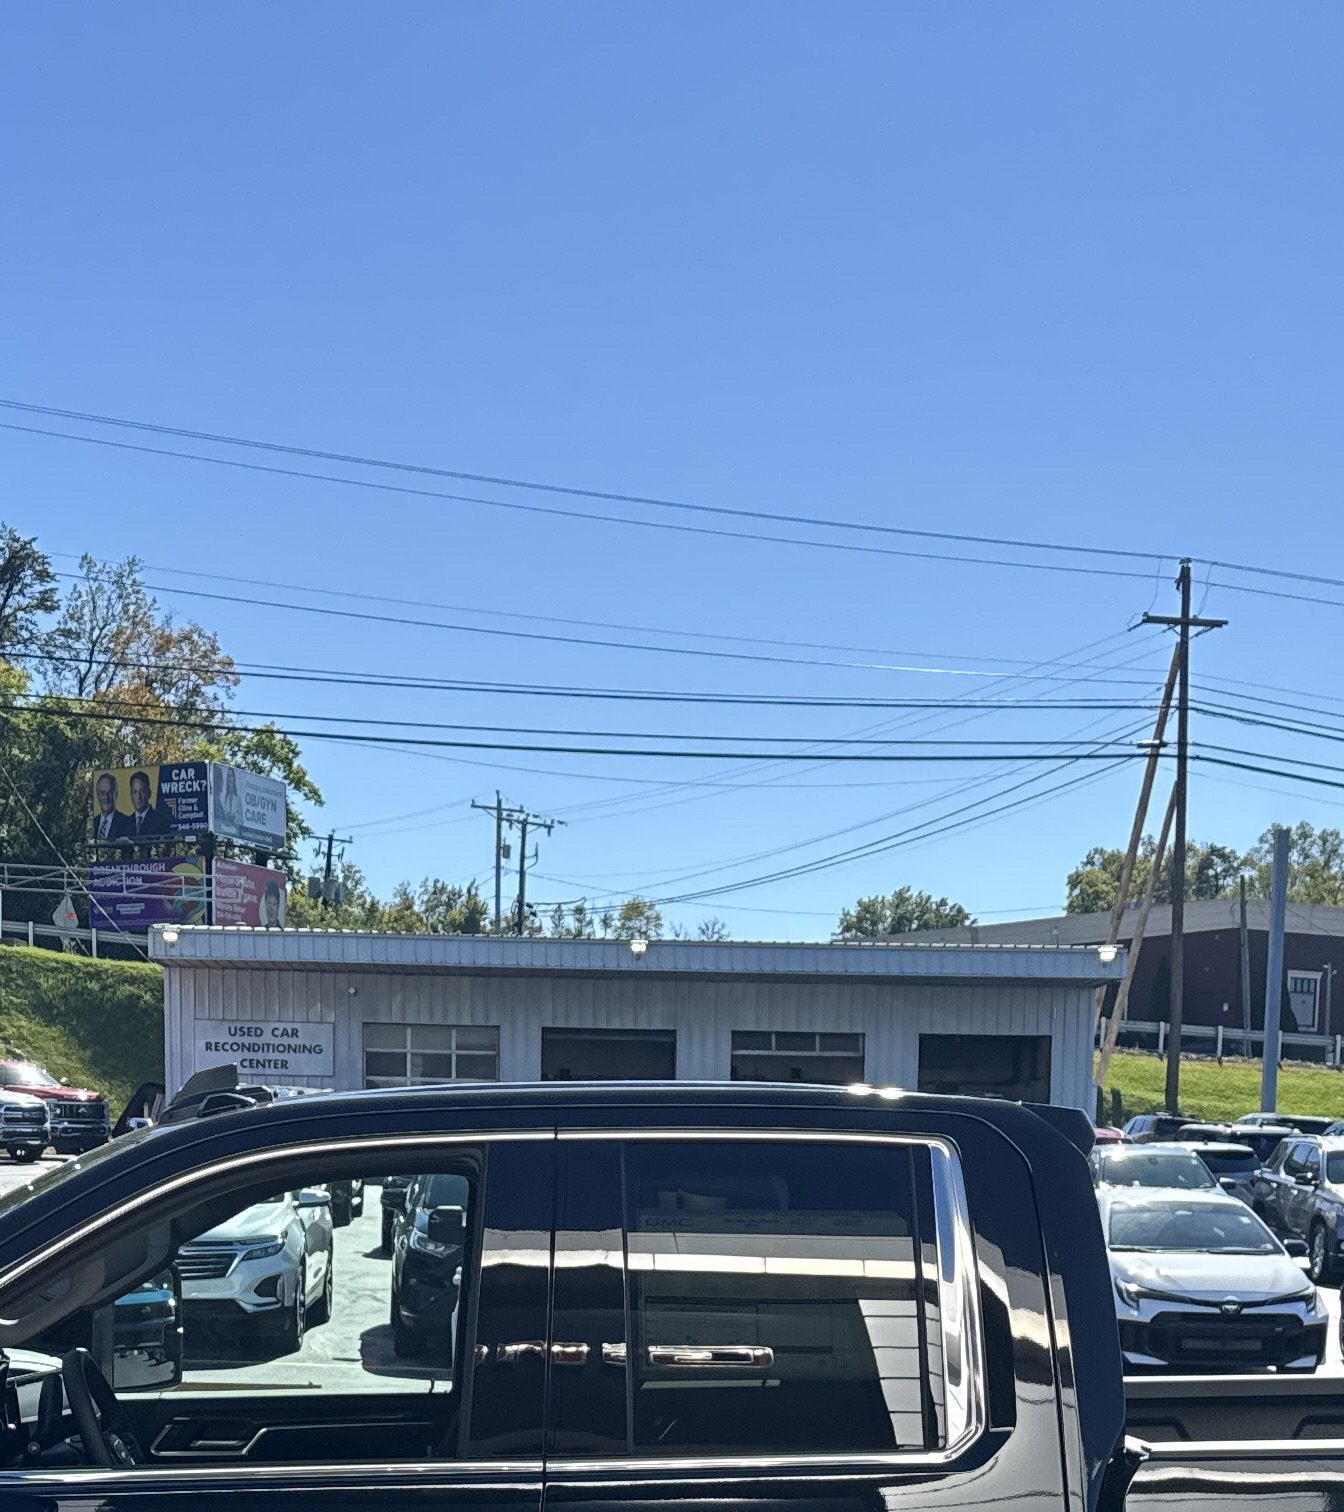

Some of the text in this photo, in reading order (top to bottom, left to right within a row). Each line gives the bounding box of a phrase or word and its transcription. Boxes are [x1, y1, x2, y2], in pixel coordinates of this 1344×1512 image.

[171, 768, 196, 780] CAR
[160, 780, 207, 794] WRECK?
[244, 792, 277, 813] OB/GYN
[244, 807, 267, 826] CARE
[228, 1026, 299, 1038] USED CAR
[205, 1041, 323, 1054] RECONDITIONING
[240, 1058, 289, 1069] CENTER
